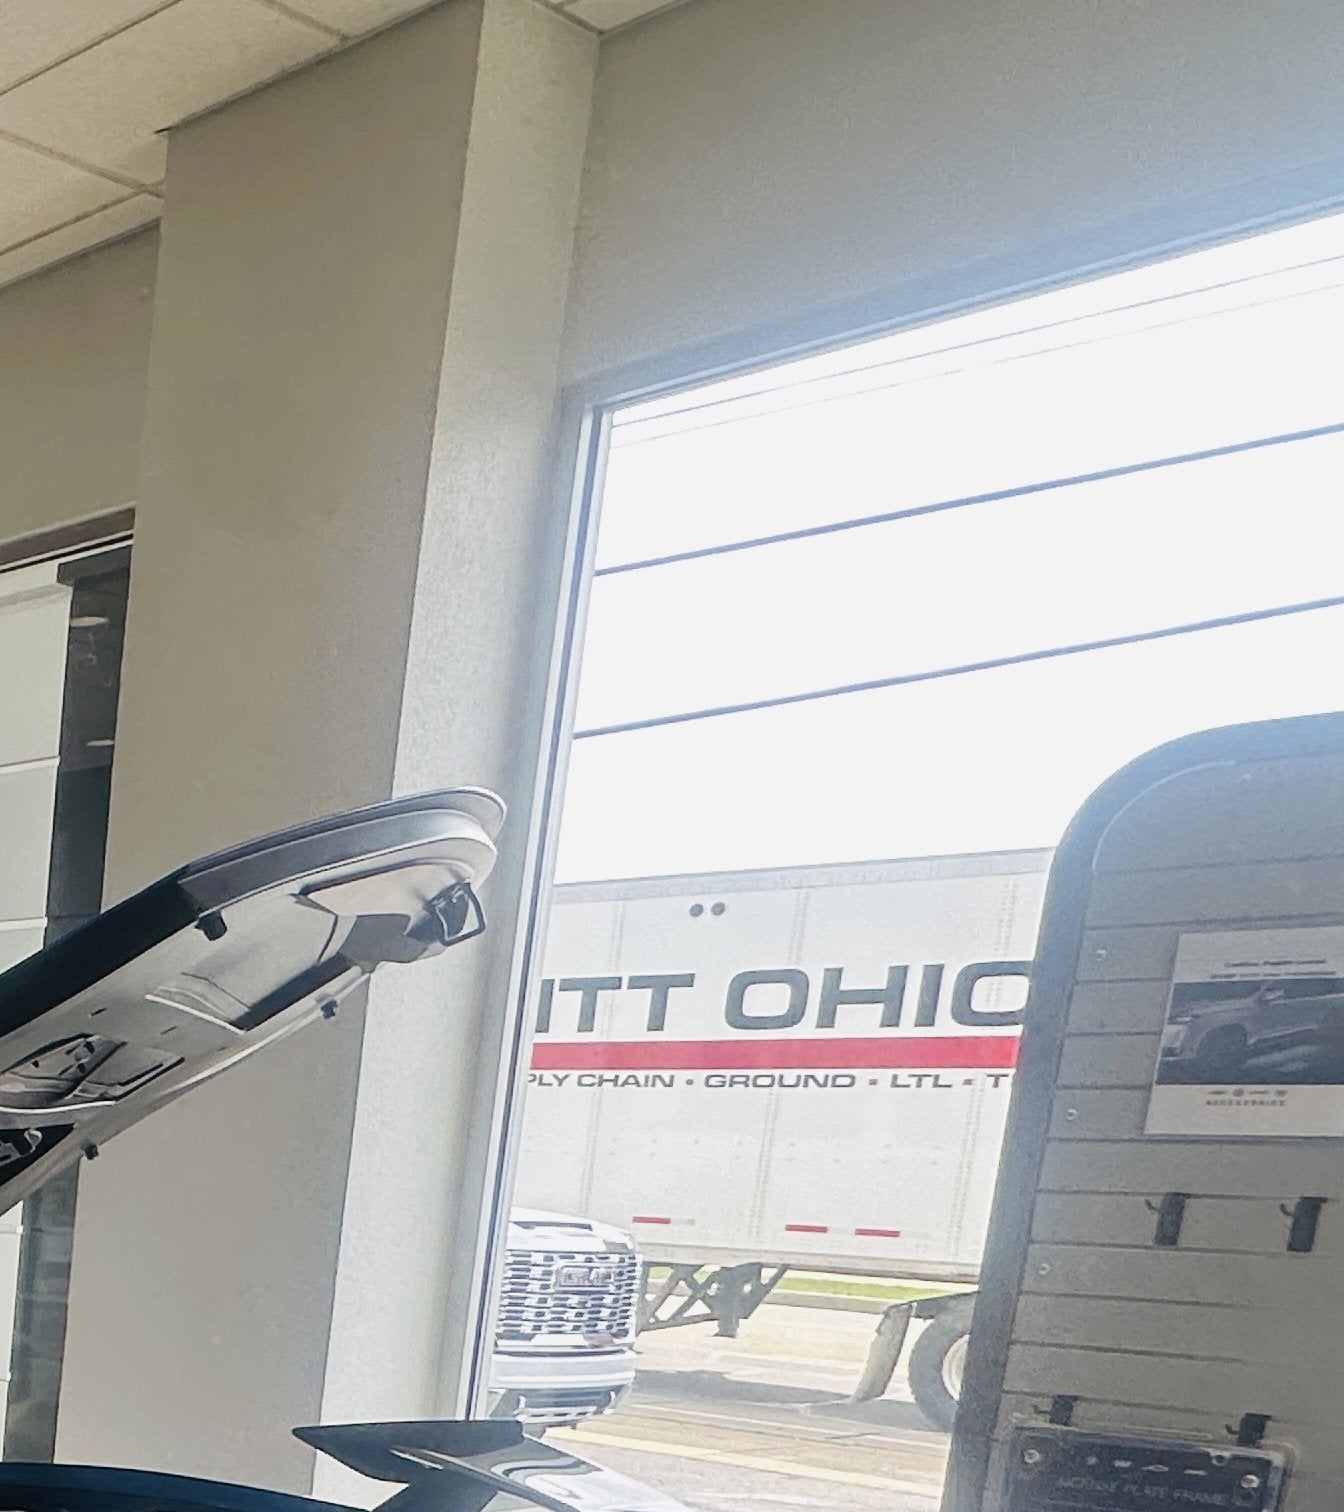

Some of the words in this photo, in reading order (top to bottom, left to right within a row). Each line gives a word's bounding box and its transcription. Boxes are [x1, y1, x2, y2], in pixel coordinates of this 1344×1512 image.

[724, 960, 1034, 1031] OHIO
[576, 1073, 675, 1089] CHAIN
[703, 1073, 857, 1089] GROUND
[889, 1073, 953, 1089] LTL
